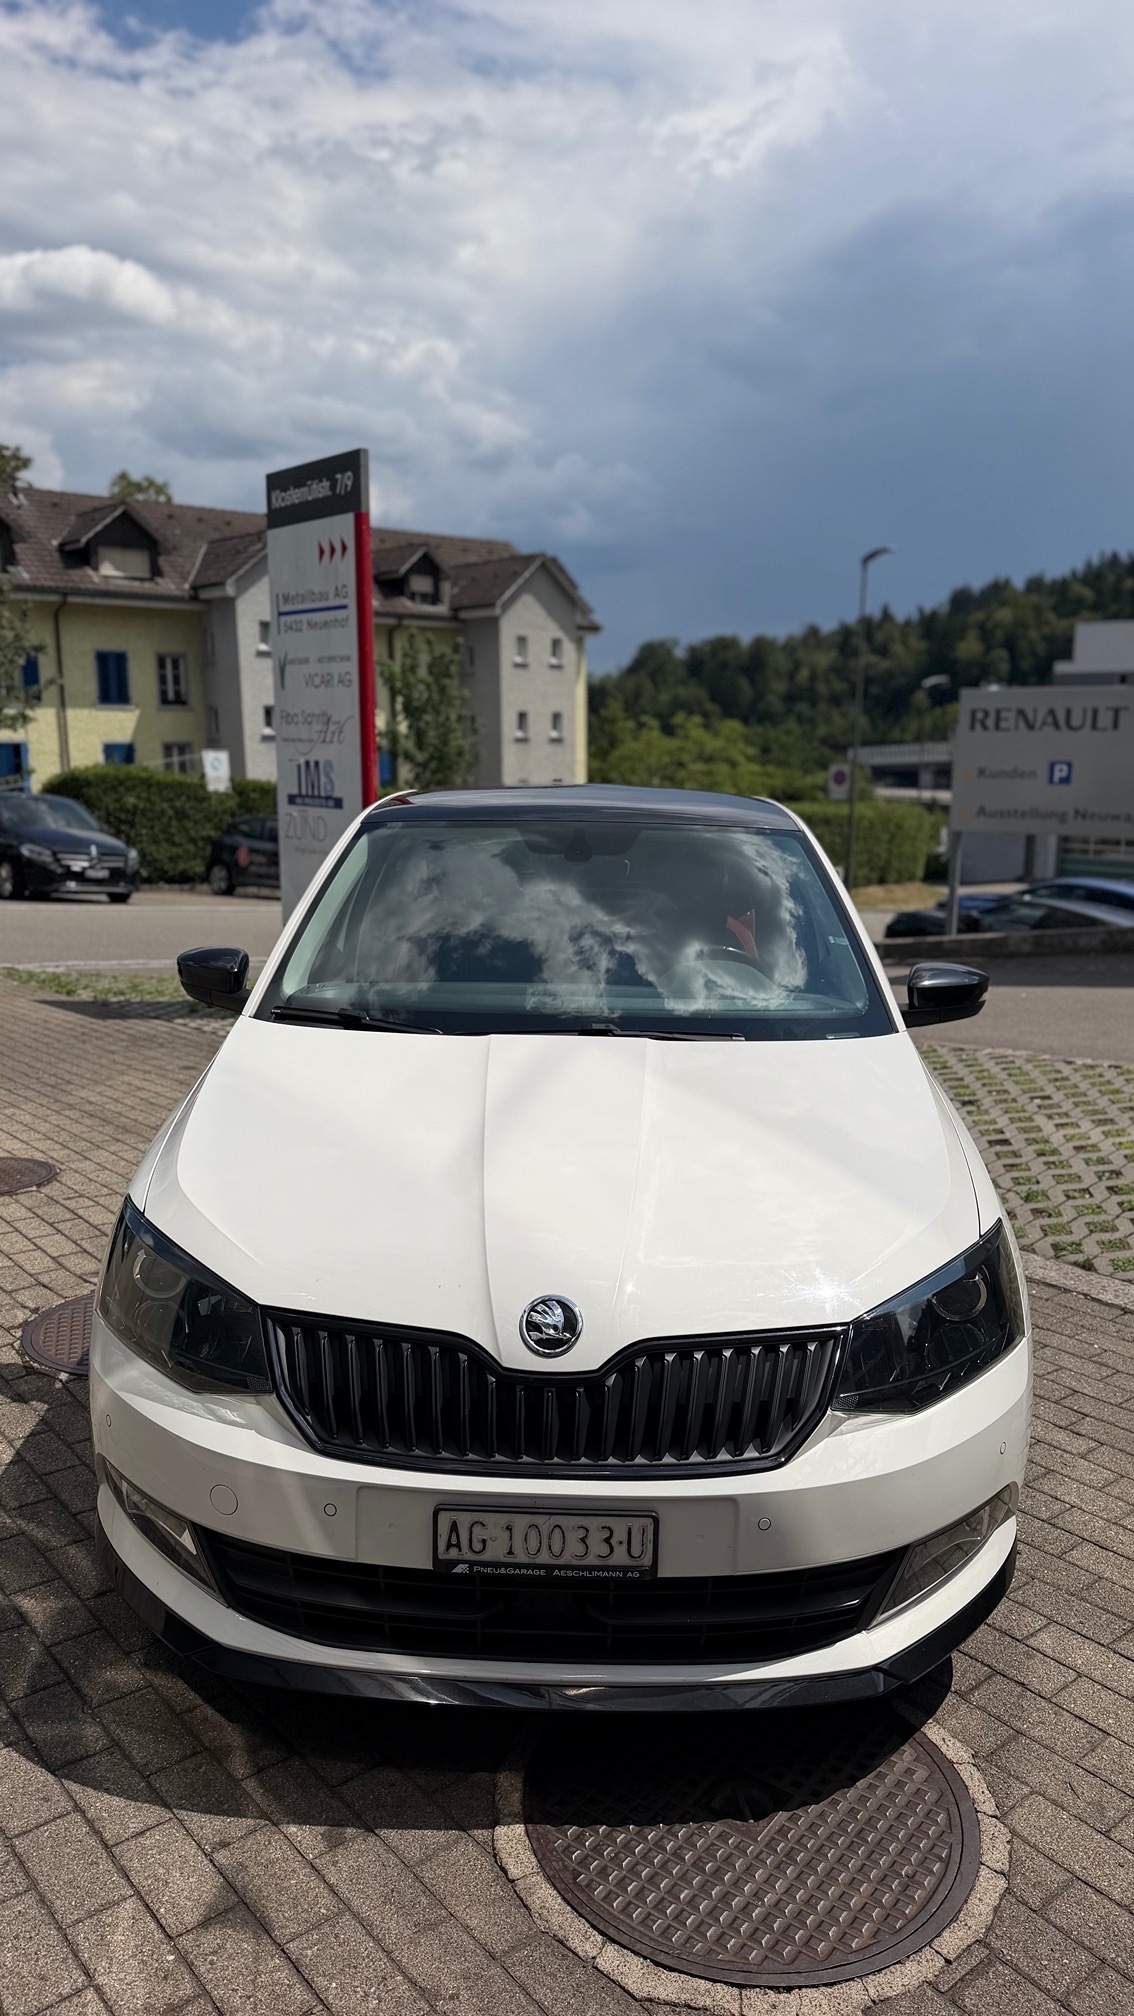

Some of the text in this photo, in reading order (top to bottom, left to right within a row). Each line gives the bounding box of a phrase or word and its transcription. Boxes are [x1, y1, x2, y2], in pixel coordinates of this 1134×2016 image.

[334, 470, 354, 496] 7/9
[281, 584, 349, 606] Metallbau AG
[282, 614, 350, 635] 5432 Neuenhof
[302, 670, 353, 689] VICARI AG
[968, 704, 1130, 733] RENAULT
[976, 765, 1038, 781] Kunden
[975, 805, 1069, 825] Ausstellung
